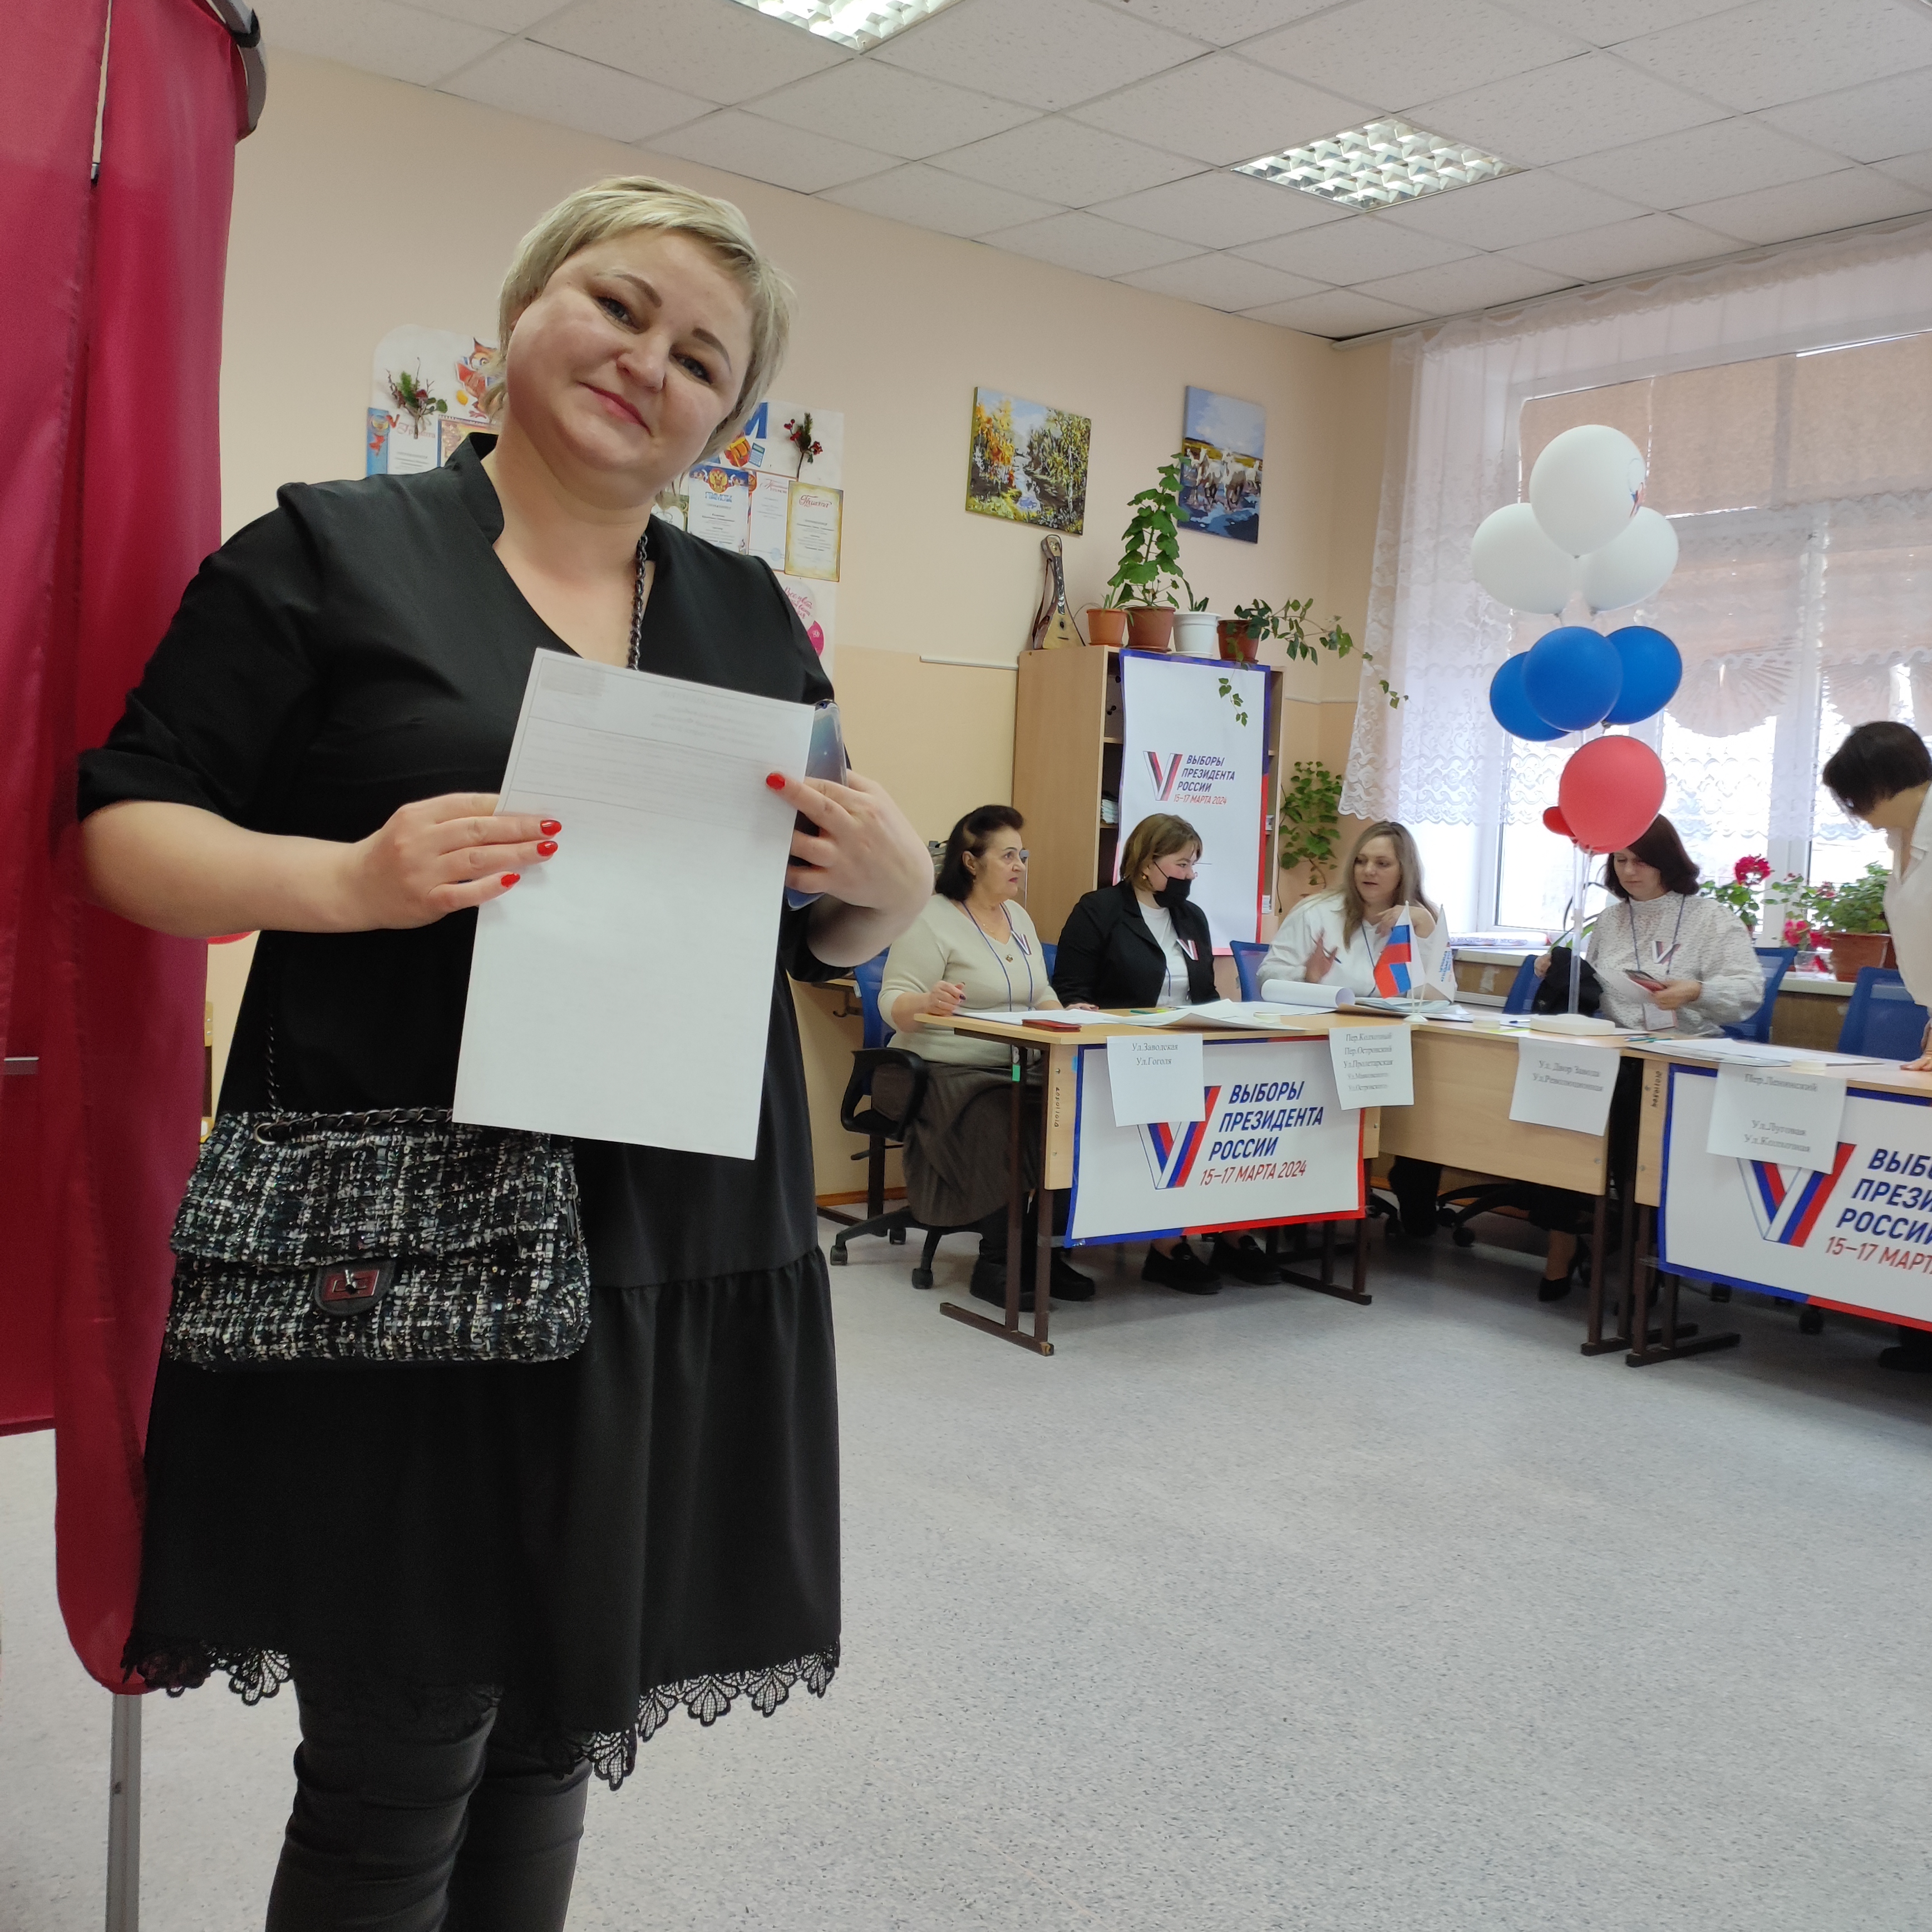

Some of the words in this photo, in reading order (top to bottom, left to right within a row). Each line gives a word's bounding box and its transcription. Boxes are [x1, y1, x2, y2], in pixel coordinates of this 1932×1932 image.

[1186, 755, 1225, 767] ВЫБОРЫ
[1181, 768, 1235, 781] ПРЕЗИДЕНТА
[1176, 781, 1212, 792] РОССИИ
[1190, 795, 1211, 804] МАРТА
[1212, 796, 1226, 805] 2024
[1132, 1043, 1178, 1051] Ул.Заводская
[1136, 1057, 1172, 1066] Ул.Гоголя
[1228, 1081, 1305, 1105] ВЫБОРЫ
[1219, 1106, 1324, 1133] ПРЕЗИДЕНТА
[1208, 1136, 1279, 1161] РОССИИ
[1234, 1162, 1277, 1183] МАРТА
[1277, 1160, 1307, 1179] 2024
[1867, 1148, 1932, 1180] ВЫБ
[1878, 1246, 1932, 1275] МАРТ
